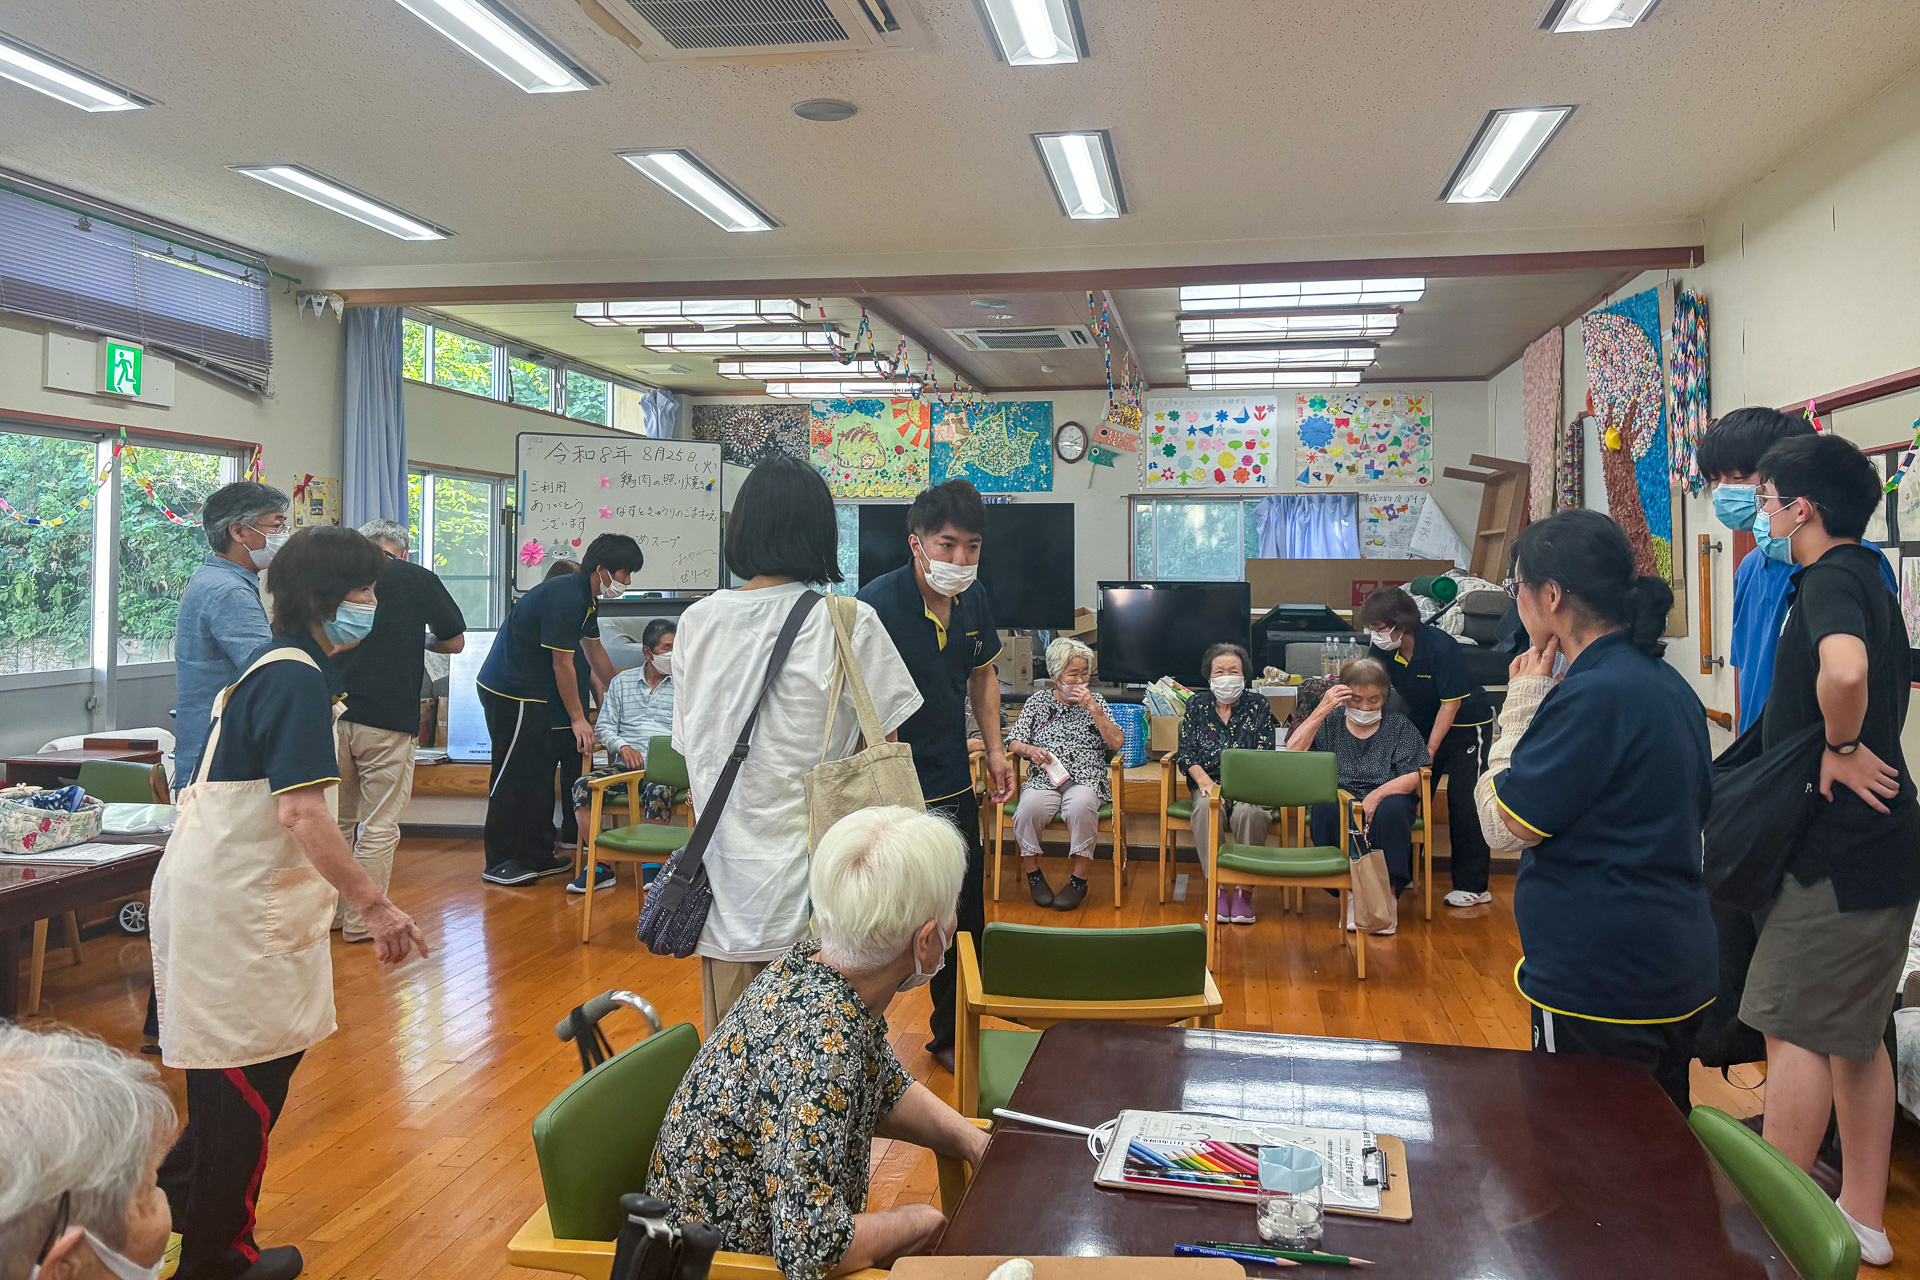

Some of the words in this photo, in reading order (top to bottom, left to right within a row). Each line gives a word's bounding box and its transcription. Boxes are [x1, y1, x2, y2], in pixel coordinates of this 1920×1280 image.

[544, 442, 632, 465] 令和8年
[643, 446, 697, 463] 8月25日
[530, 480, 567, 494] ご利用
[620, 471, 705, 491] 鶏肉の照り焼き
[829, 485, 917, 498] 島デイサービス
[531, 499, 584, 515] ありがとう
[616, 505, 717, 523] なすときゅうりのごま和え
[541, 516, 587, 533] ございます
[635, 533, 681, 549] めスープ
